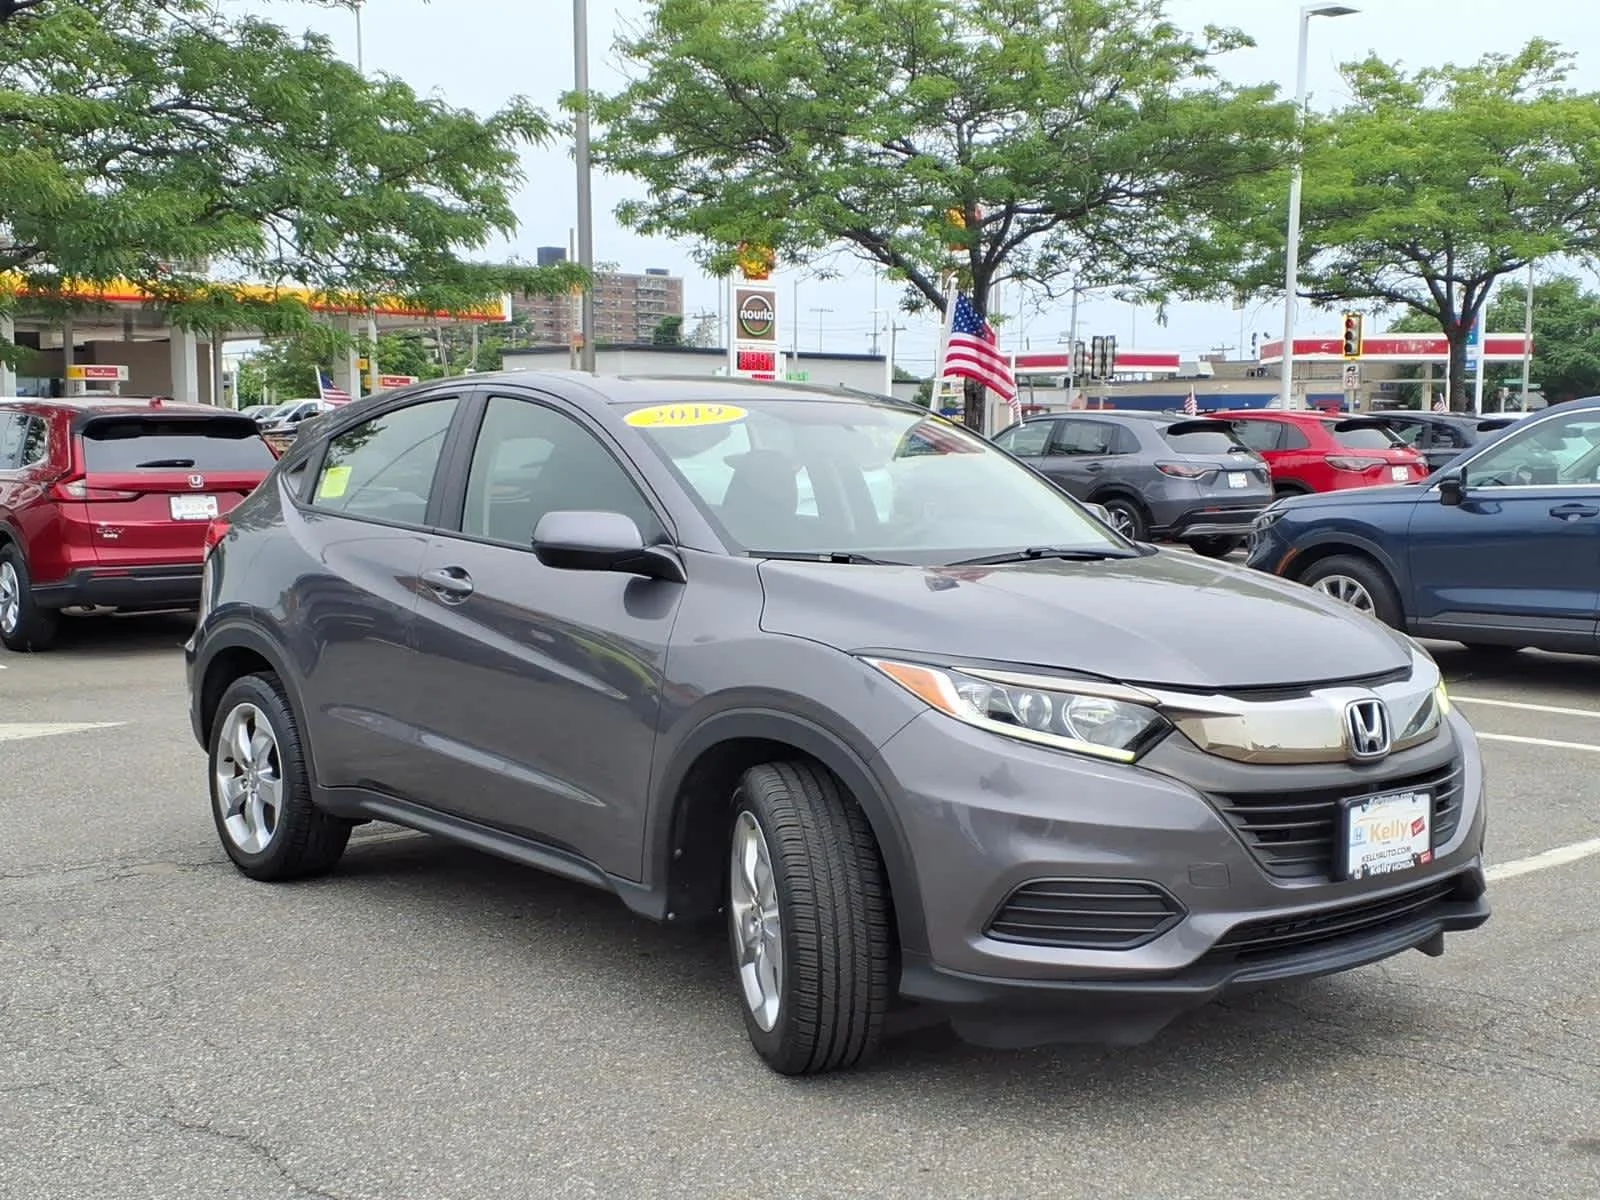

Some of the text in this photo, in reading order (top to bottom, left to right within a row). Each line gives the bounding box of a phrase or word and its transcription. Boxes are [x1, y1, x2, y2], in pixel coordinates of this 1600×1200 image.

[739, 308, 774, 321] nouria
[653, 406, 724, 424] 2019
[1370, 819, 1409, 842] Kelly
